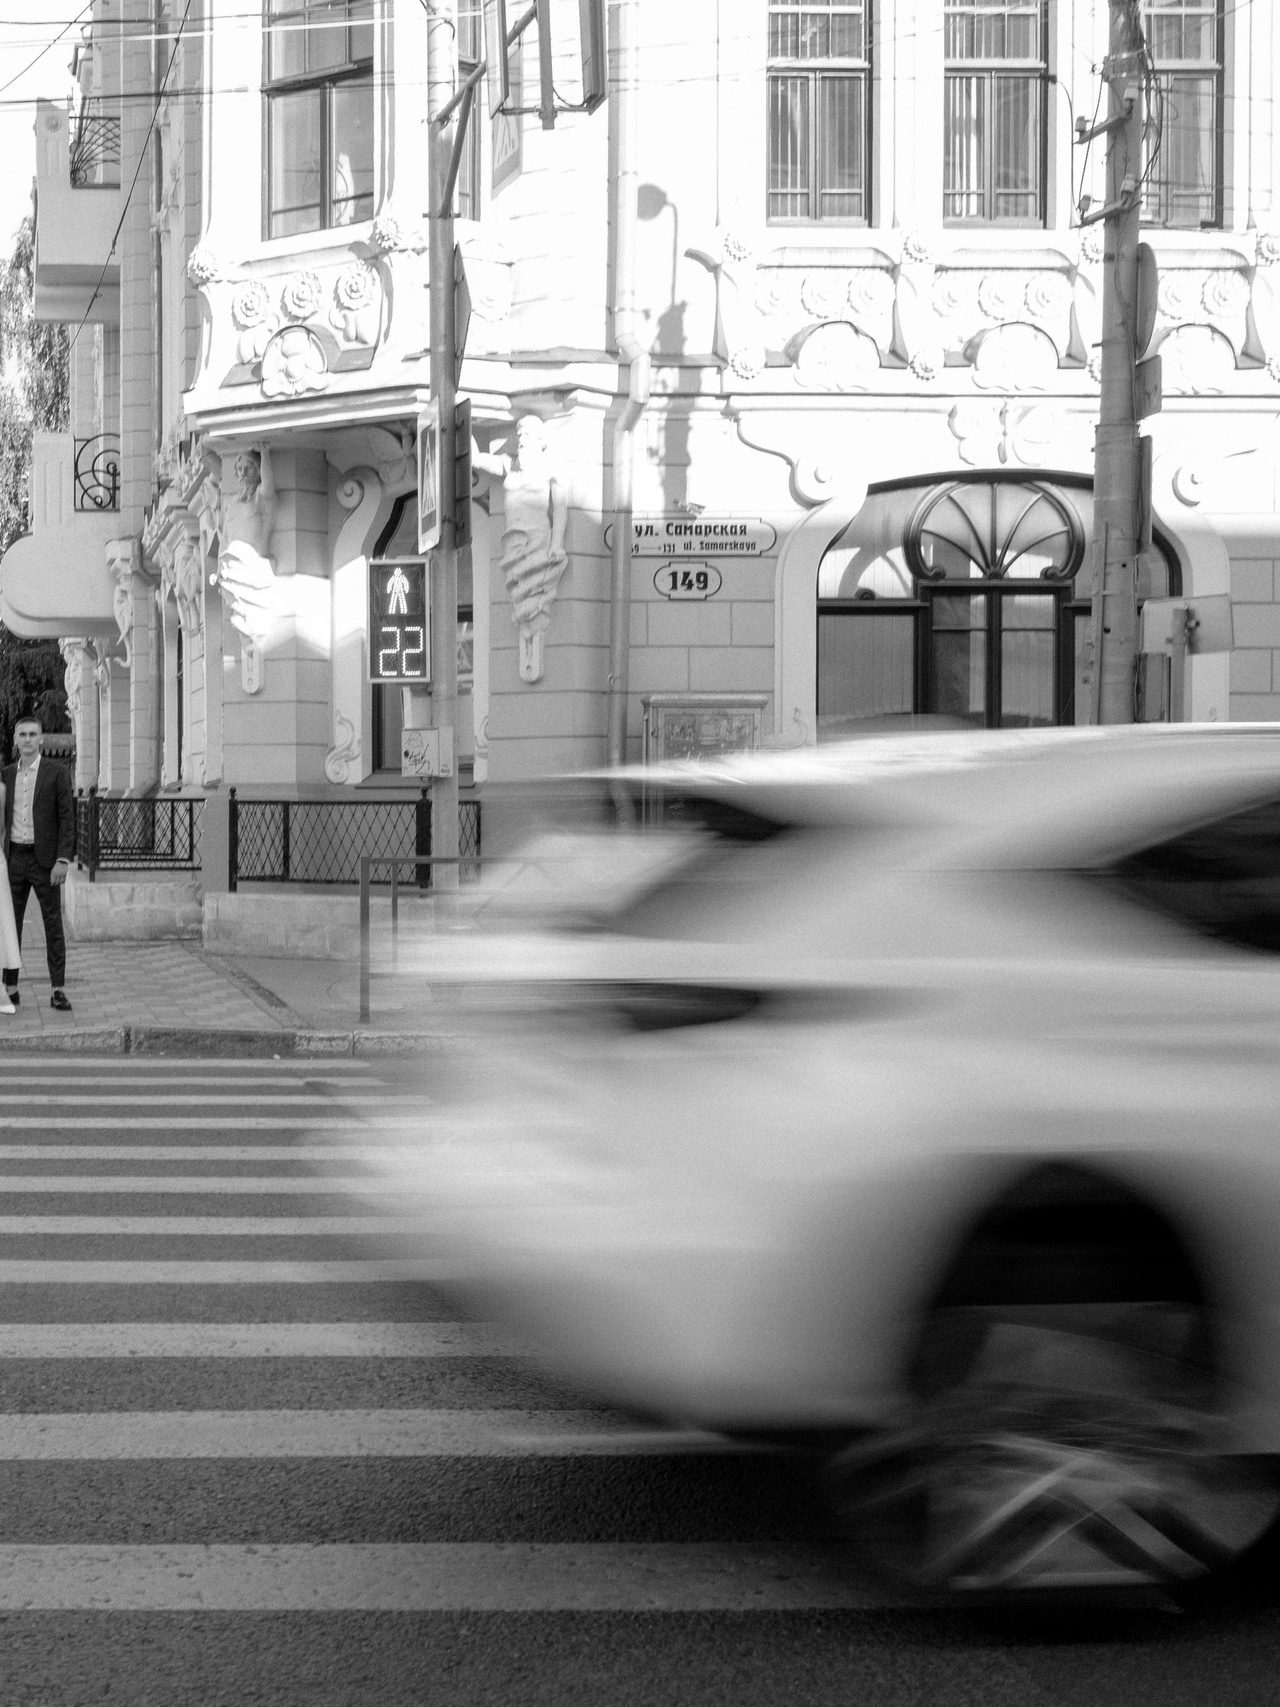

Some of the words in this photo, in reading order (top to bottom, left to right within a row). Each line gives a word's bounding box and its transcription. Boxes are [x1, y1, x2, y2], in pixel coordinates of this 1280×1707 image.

[635, 523, 659, 538] ул.
[665, 523, 747, 537] Самарская
[683, 541, 696, 551] ul.
[699, 540, 756, 552] Samarskaya
[668, 571, 709, 592] 149
[380, 626, 423, 676] 22
